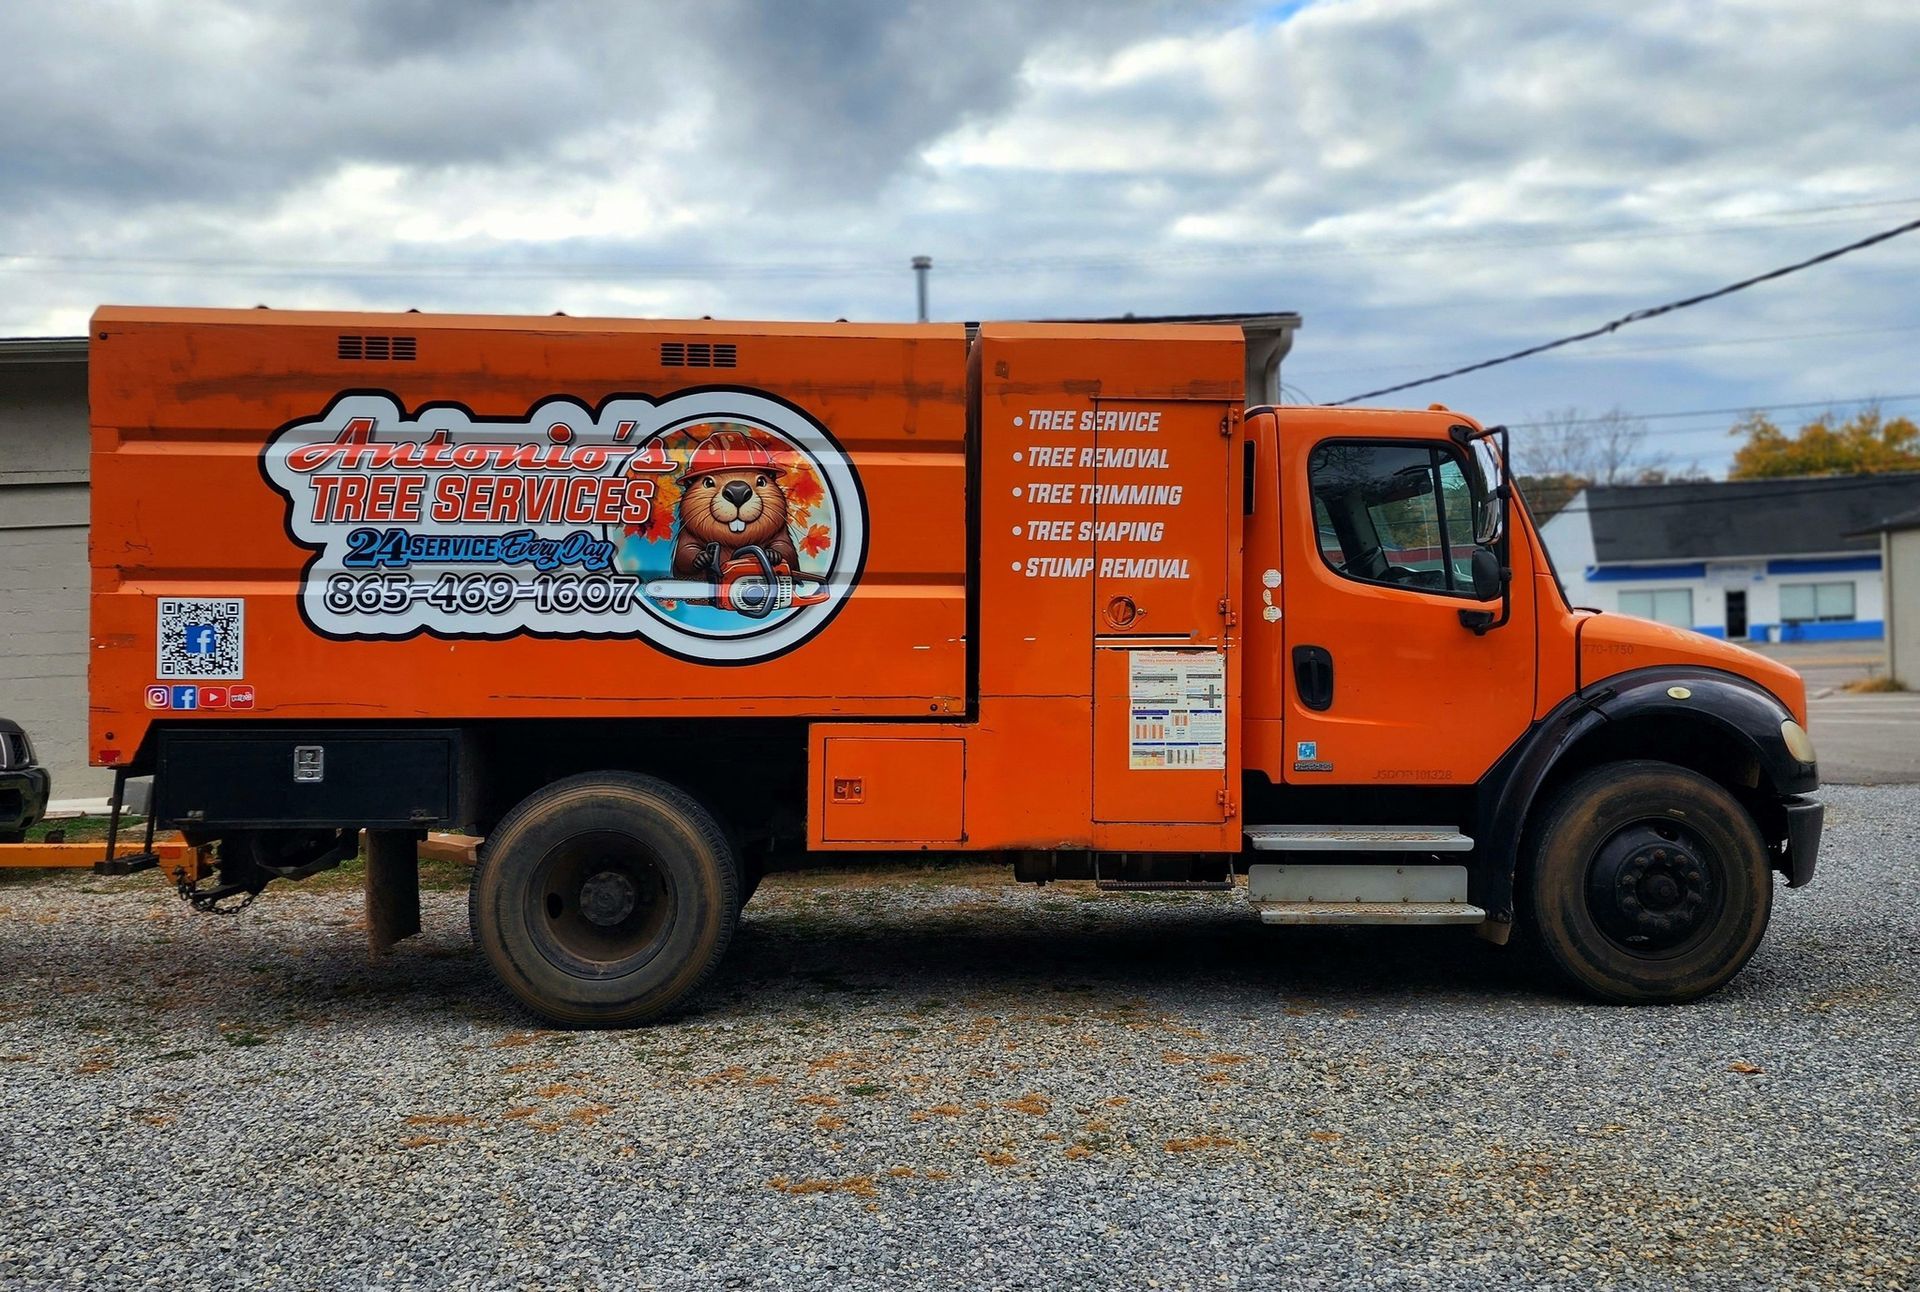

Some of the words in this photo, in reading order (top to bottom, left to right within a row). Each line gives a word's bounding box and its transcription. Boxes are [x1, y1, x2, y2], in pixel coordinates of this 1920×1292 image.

[1028, 410, 1077, 431] TREE
[1079, 410, 1161, 432] SERVICE
[286, 417, 678, 472] Antonio's
[1028, 447, 1076, 467] TREE
[1079, 447, 1169, 469] REMOVAL
[310, 474, 427, 523] TREE
[431, 475, 655, 525] SERVICES
[1027, 484, 1076, 504] TREE
[1079, 484, 1183, 506] TRIMMING
[1027, 521, 1075, 541] TREE
[1077, 521, 1165, 542] SHAPING
[343, 528, 410, 567] 24
[409, 536, 499, 561] SERVICE
[497, 529, 563, 571] Every
[562, 531, 617, 571] Day
[1025, 557, 1095, 578] STUMP
[1099, 558, 1190, 579] REMOVAL
[327, 573, 640, 614] 865-469-1607
